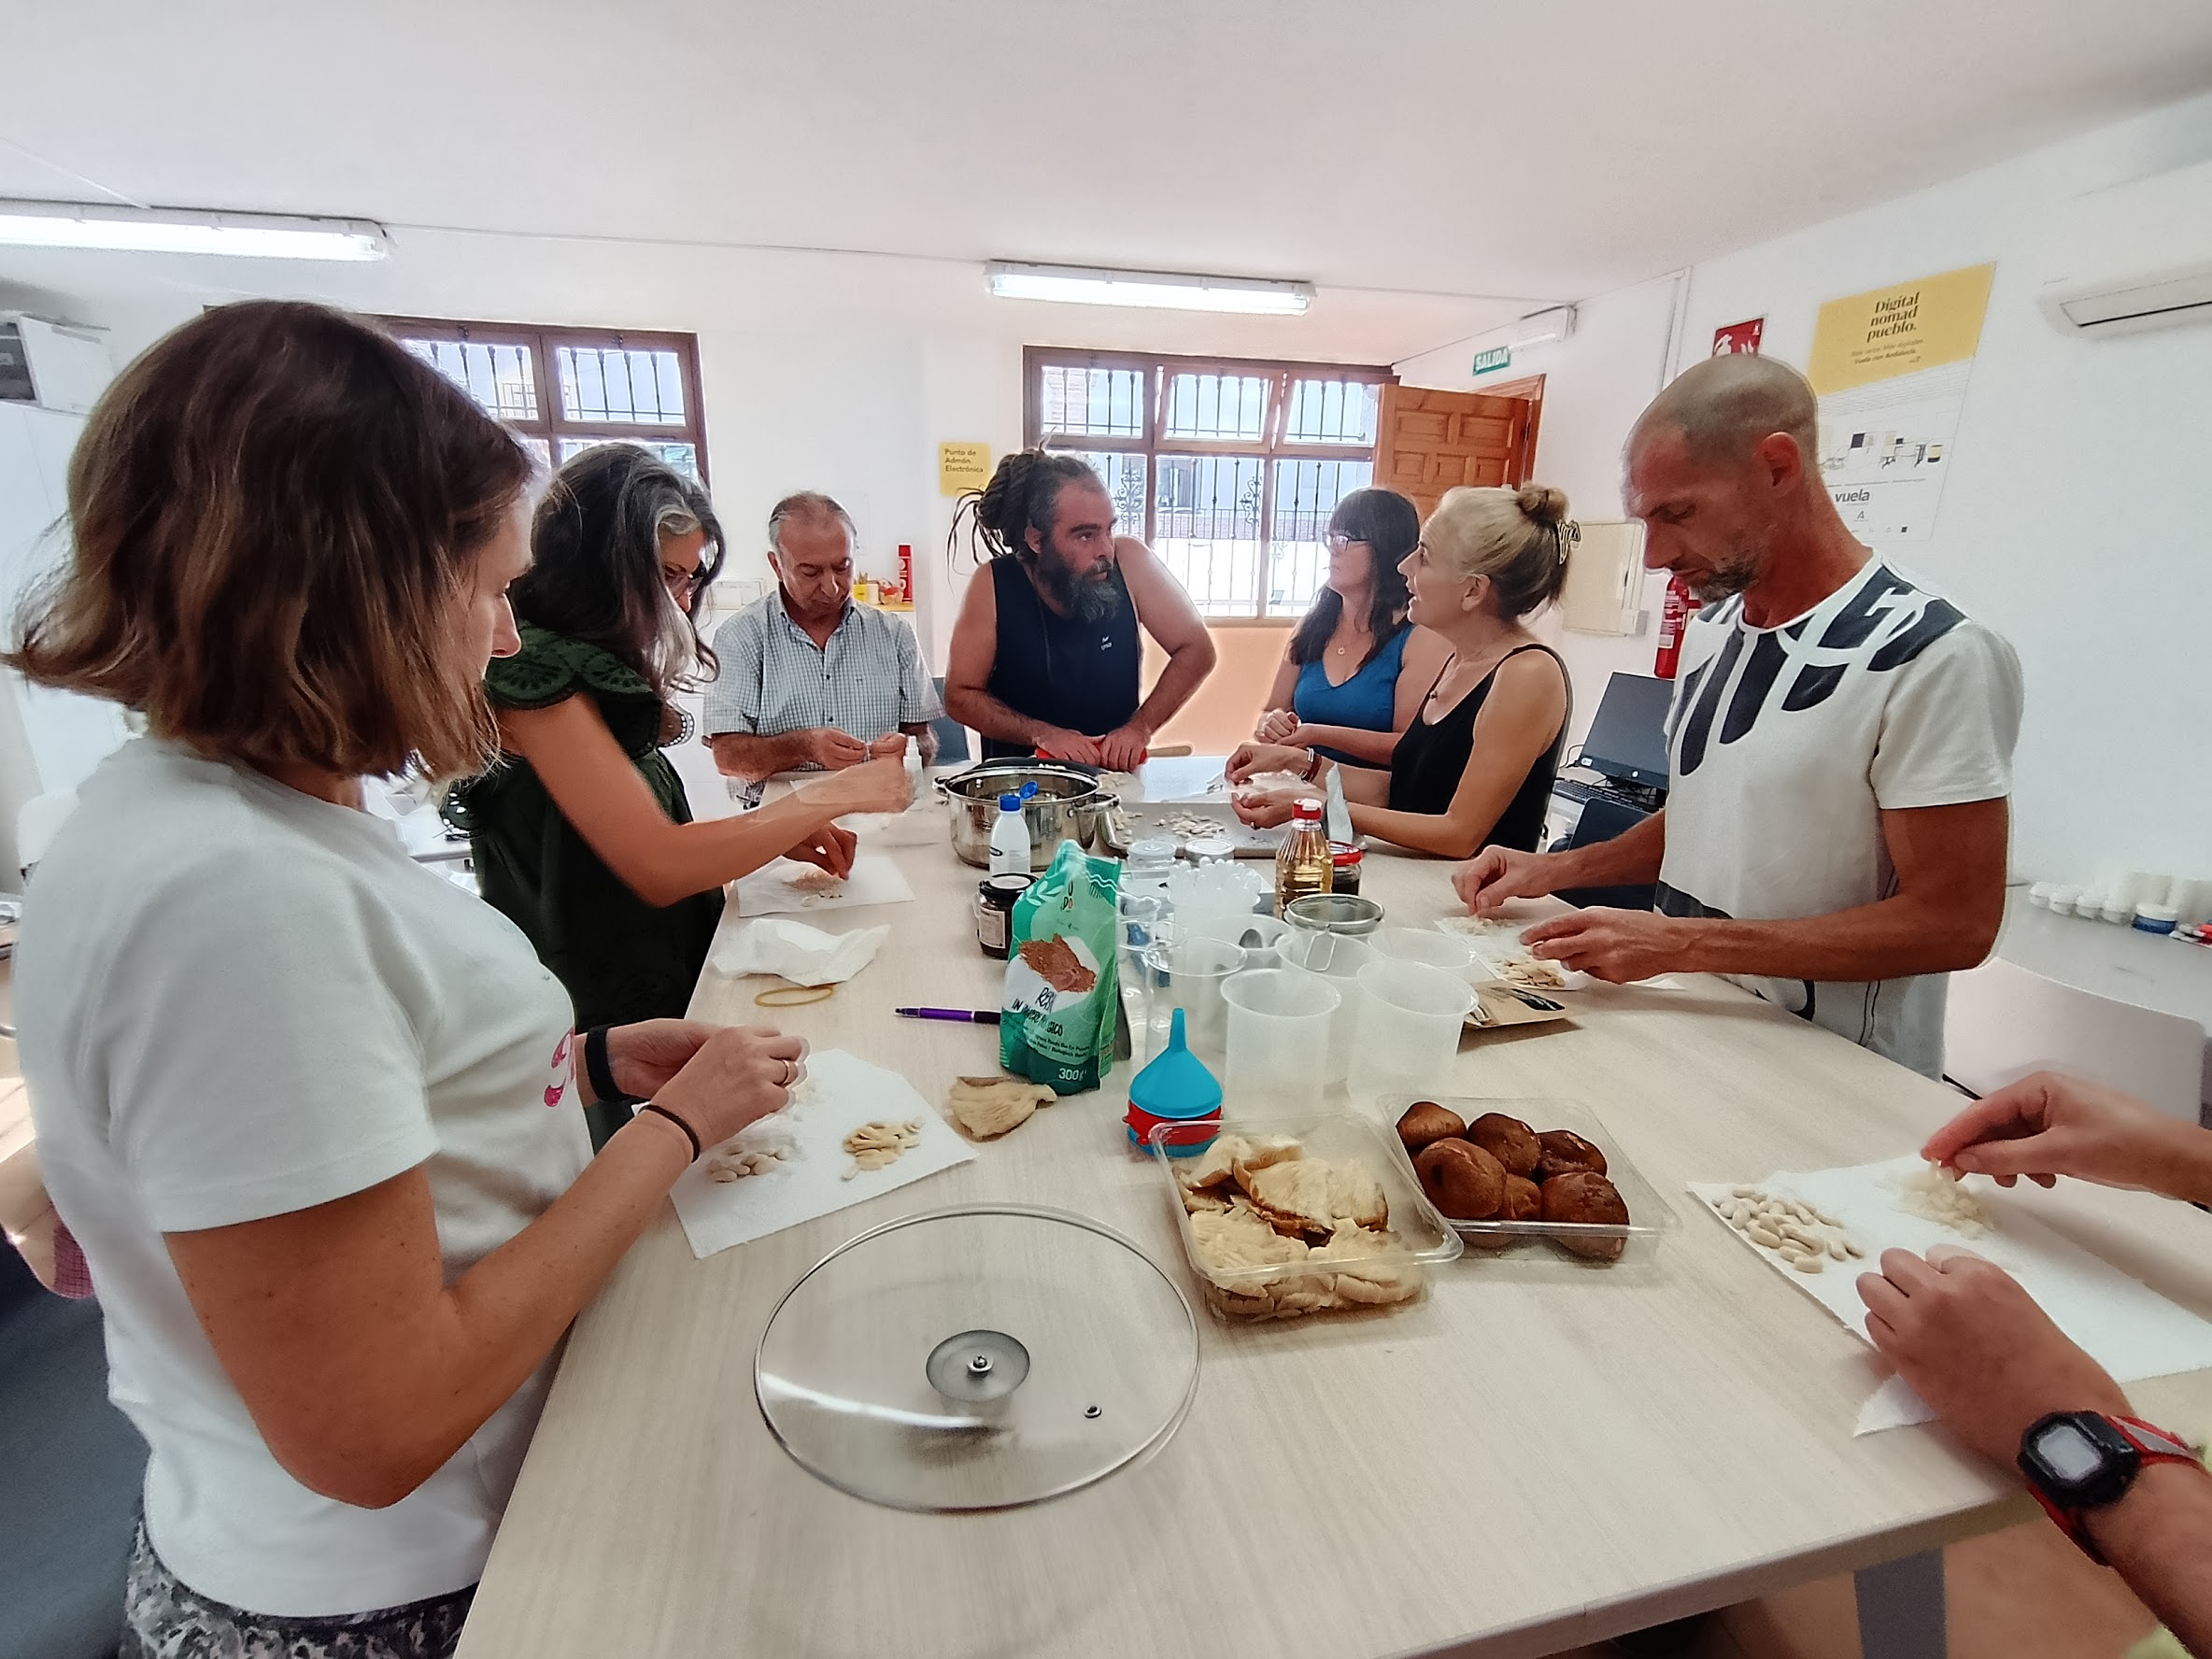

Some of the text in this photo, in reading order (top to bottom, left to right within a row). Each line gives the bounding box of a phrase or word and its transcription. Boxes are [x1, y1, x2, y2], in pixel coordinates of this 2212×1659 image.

[1875, 291, 1920, 313] Digital
[1870, 305, 1918, 327] nomad
[1866, 320, 1917, 344] pueblo.
[1476, 348, 1508, 371] SALIDA
[1836, 489, 1870, 503] vuela
